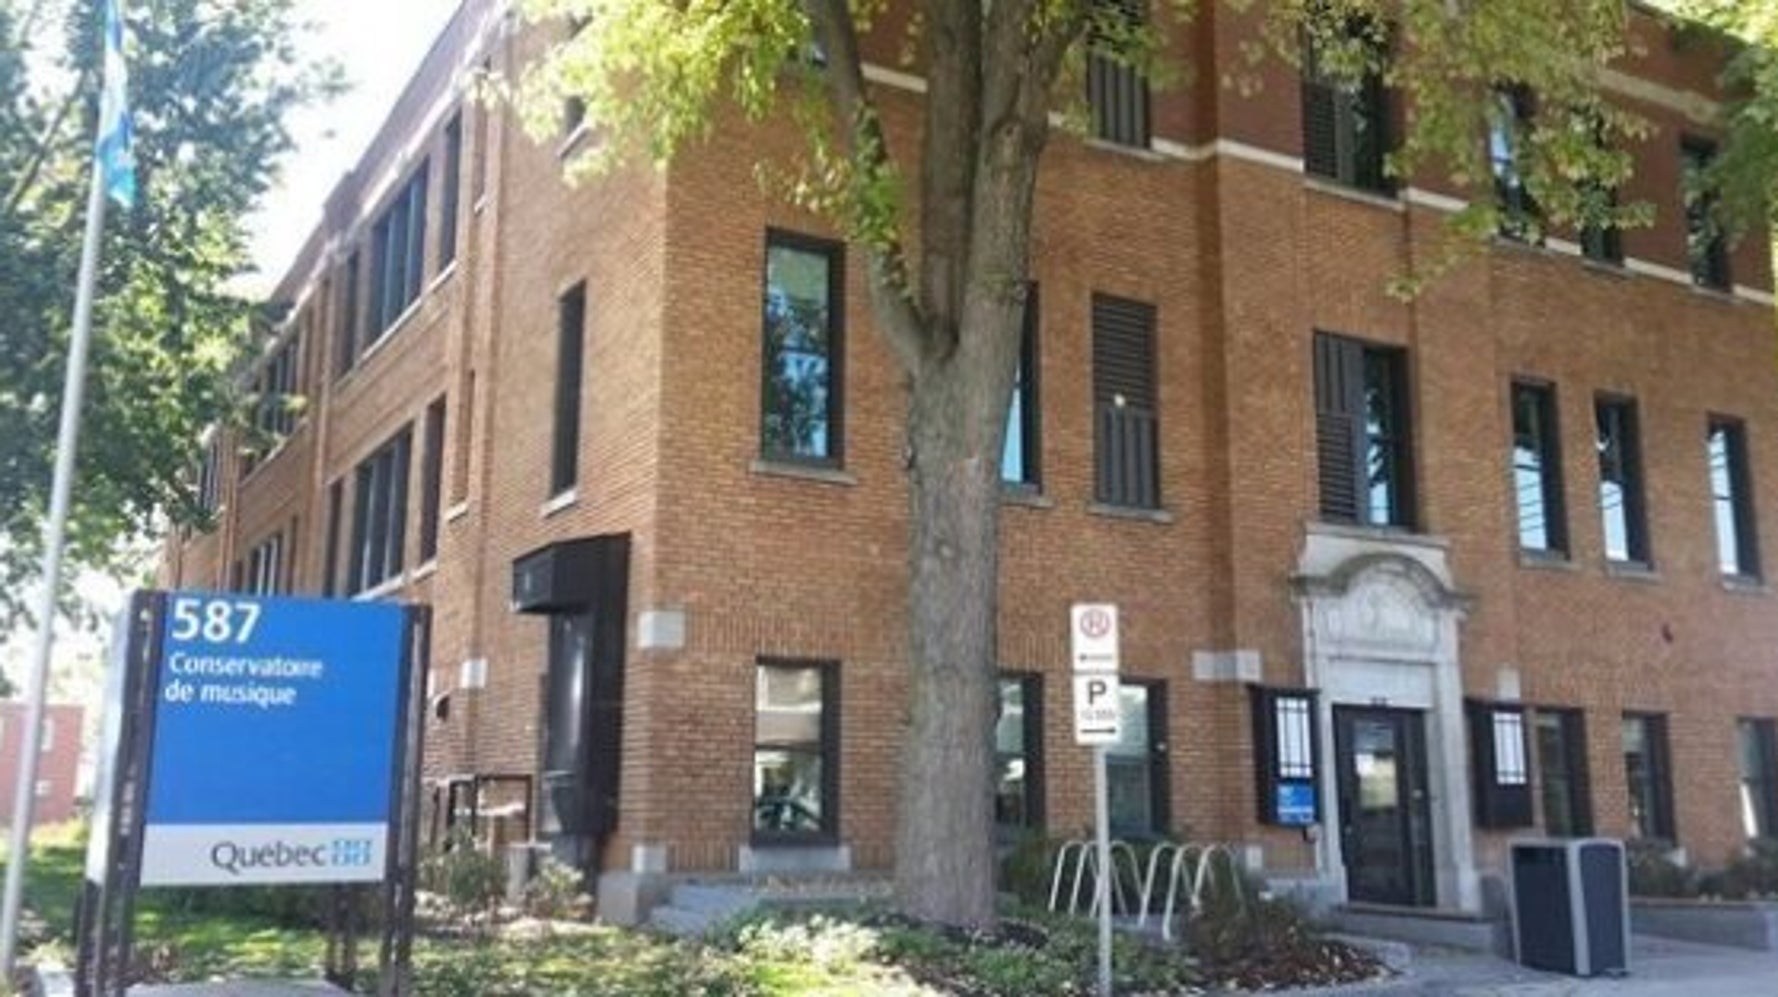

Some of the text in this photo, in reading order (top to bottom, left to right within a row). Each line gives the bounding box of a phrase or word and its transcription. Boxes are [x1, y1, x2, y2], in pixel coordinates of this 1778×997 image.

[171, 599, 261, 643] 587
[170, 652, 323, 678] Conservatoire
[165, 679, 297, 709] de musique
[1087, 681, 1107, 705] P
